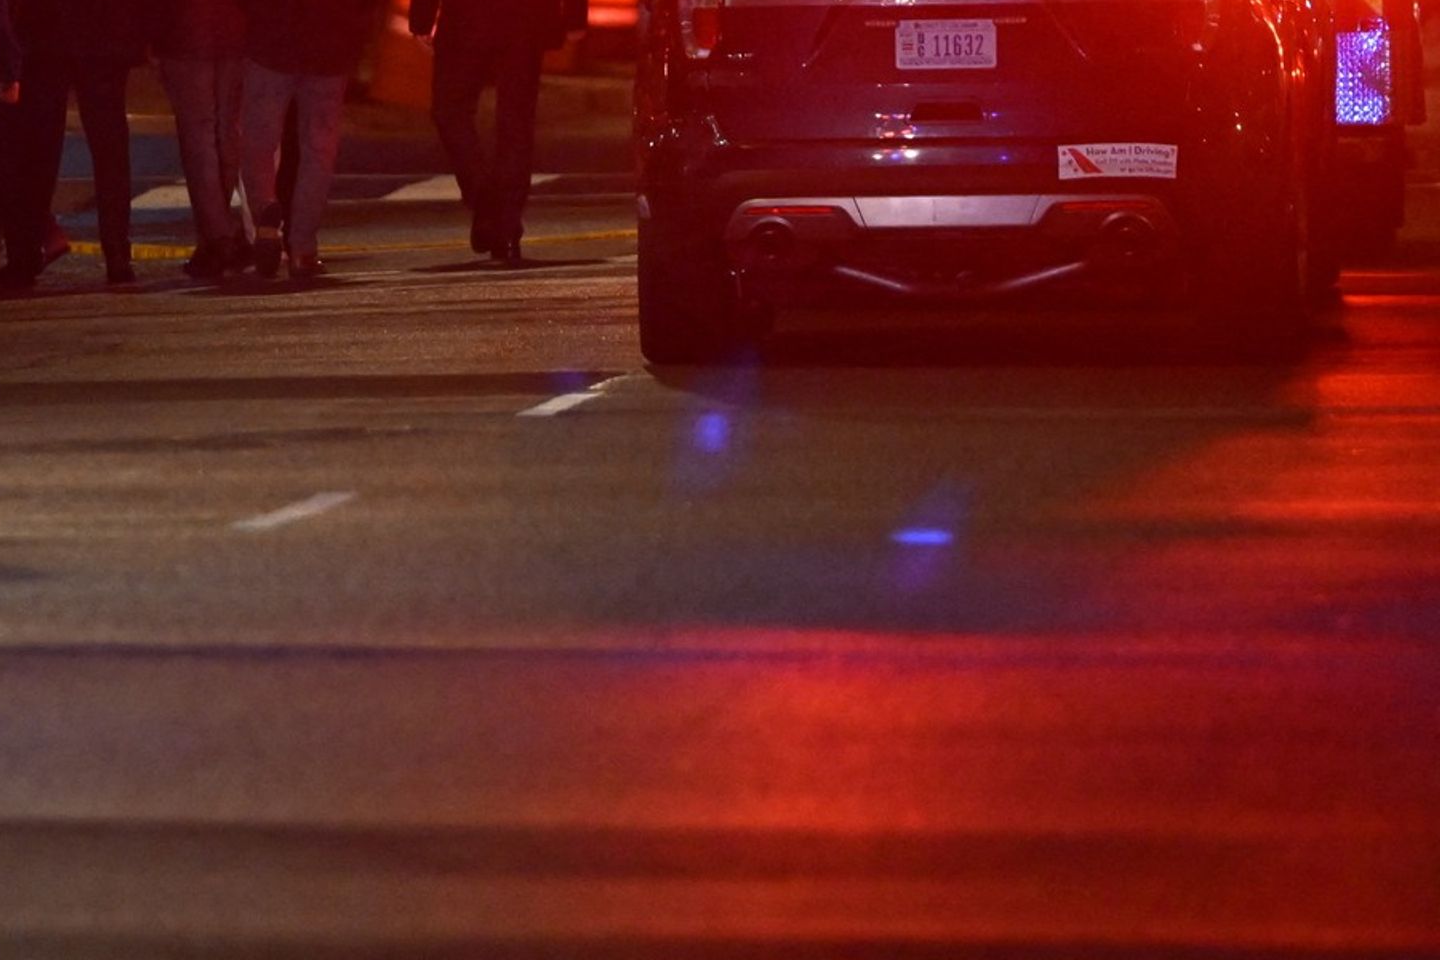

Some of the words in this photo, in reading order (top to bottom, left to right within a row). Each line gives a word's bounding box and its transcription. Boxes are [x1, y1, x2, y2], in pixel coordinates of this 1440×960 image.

[933, 34, 984, 57] 11632
[1086, 147, 1107, 156] How
[1111, 146, 1126, 155] Am
[1134, 145, 1176, 159] Driving?
